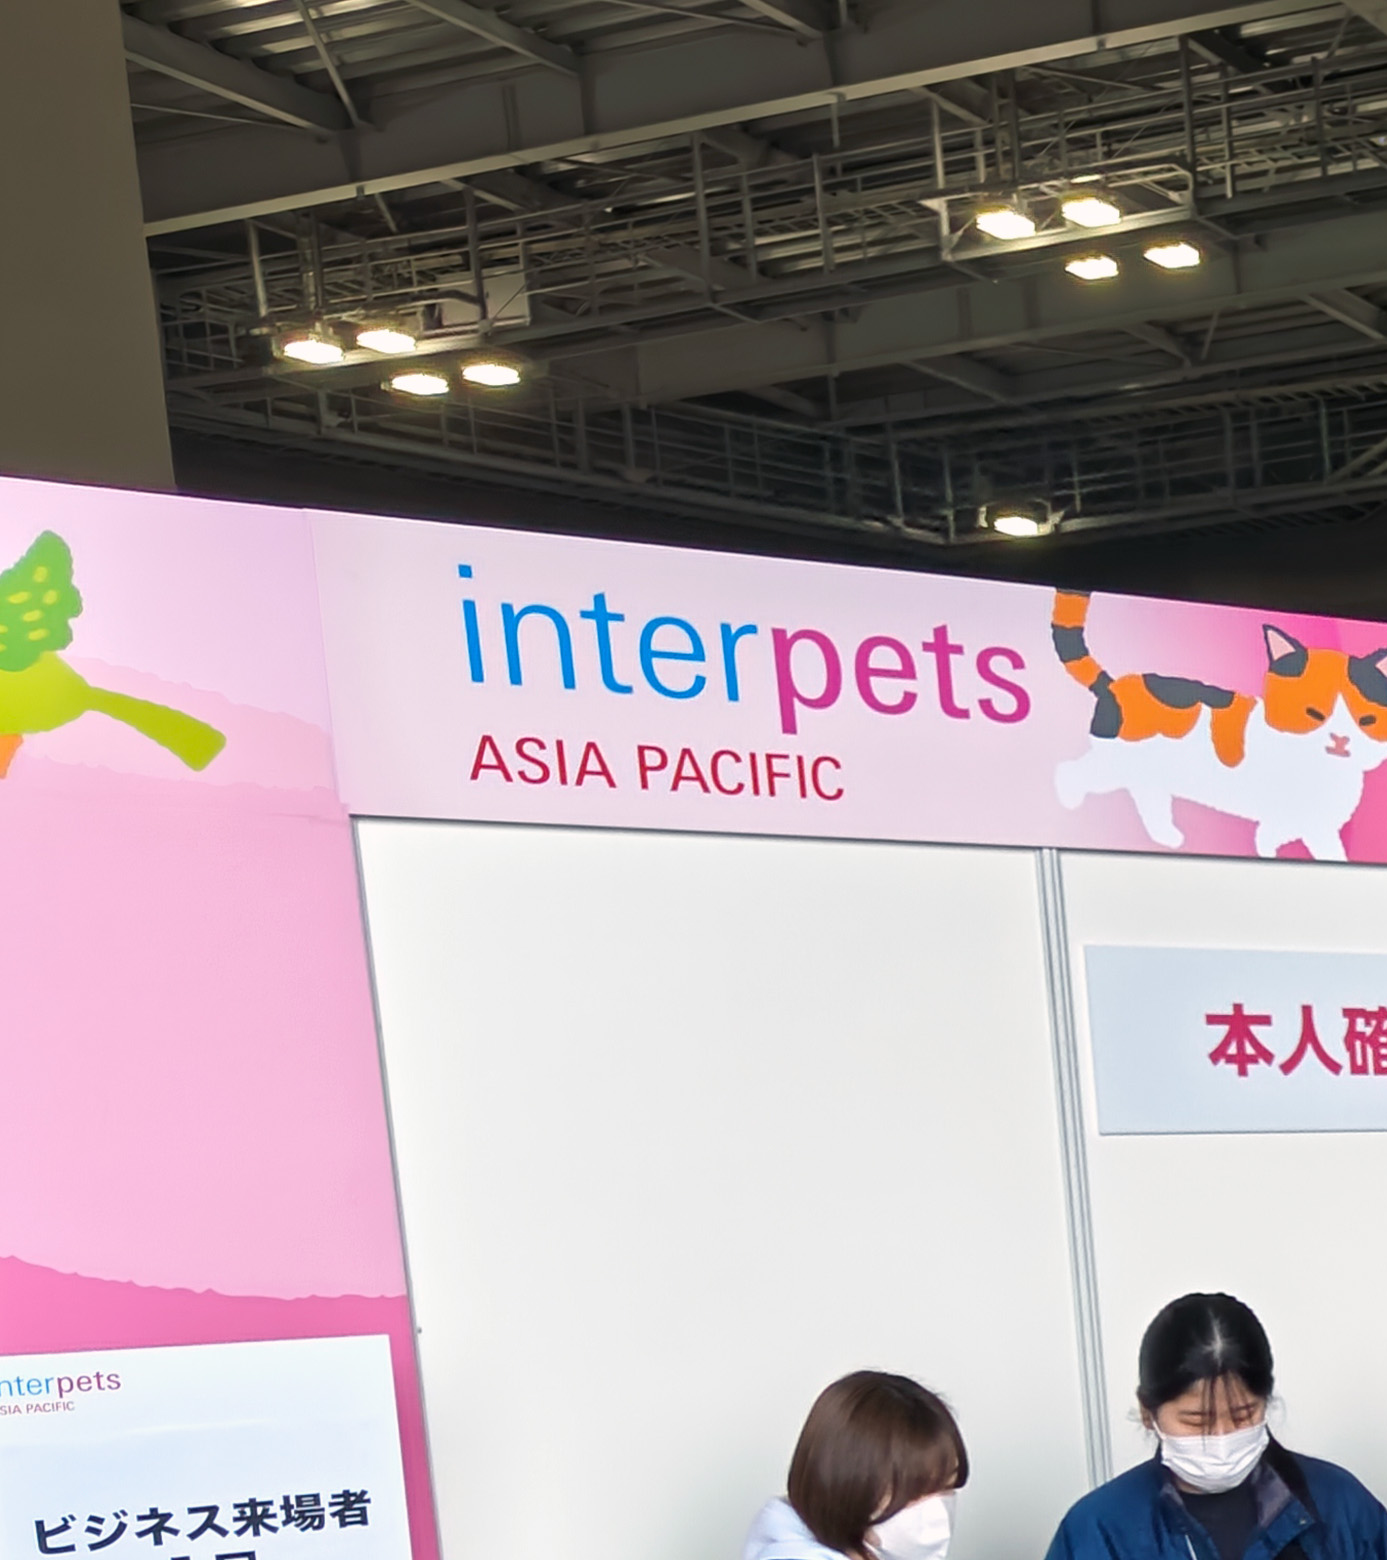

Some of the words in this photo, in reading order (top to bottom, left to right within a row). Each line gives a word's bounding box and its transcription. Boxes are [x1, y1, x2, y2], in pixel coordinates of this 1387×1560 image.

[458, 564, 1031, 734] interpets
[470, 734, 617, 789] ASIA
[637, 744, 844, 801] PACIFIC
[0, 1371, 121, 1398] nterpets
[0, 1404, 22, 1416] SIA
[26, 1401, 75, 1414] PACIFIC
[34, 1489, 371, 1555] ビジネス来場者
